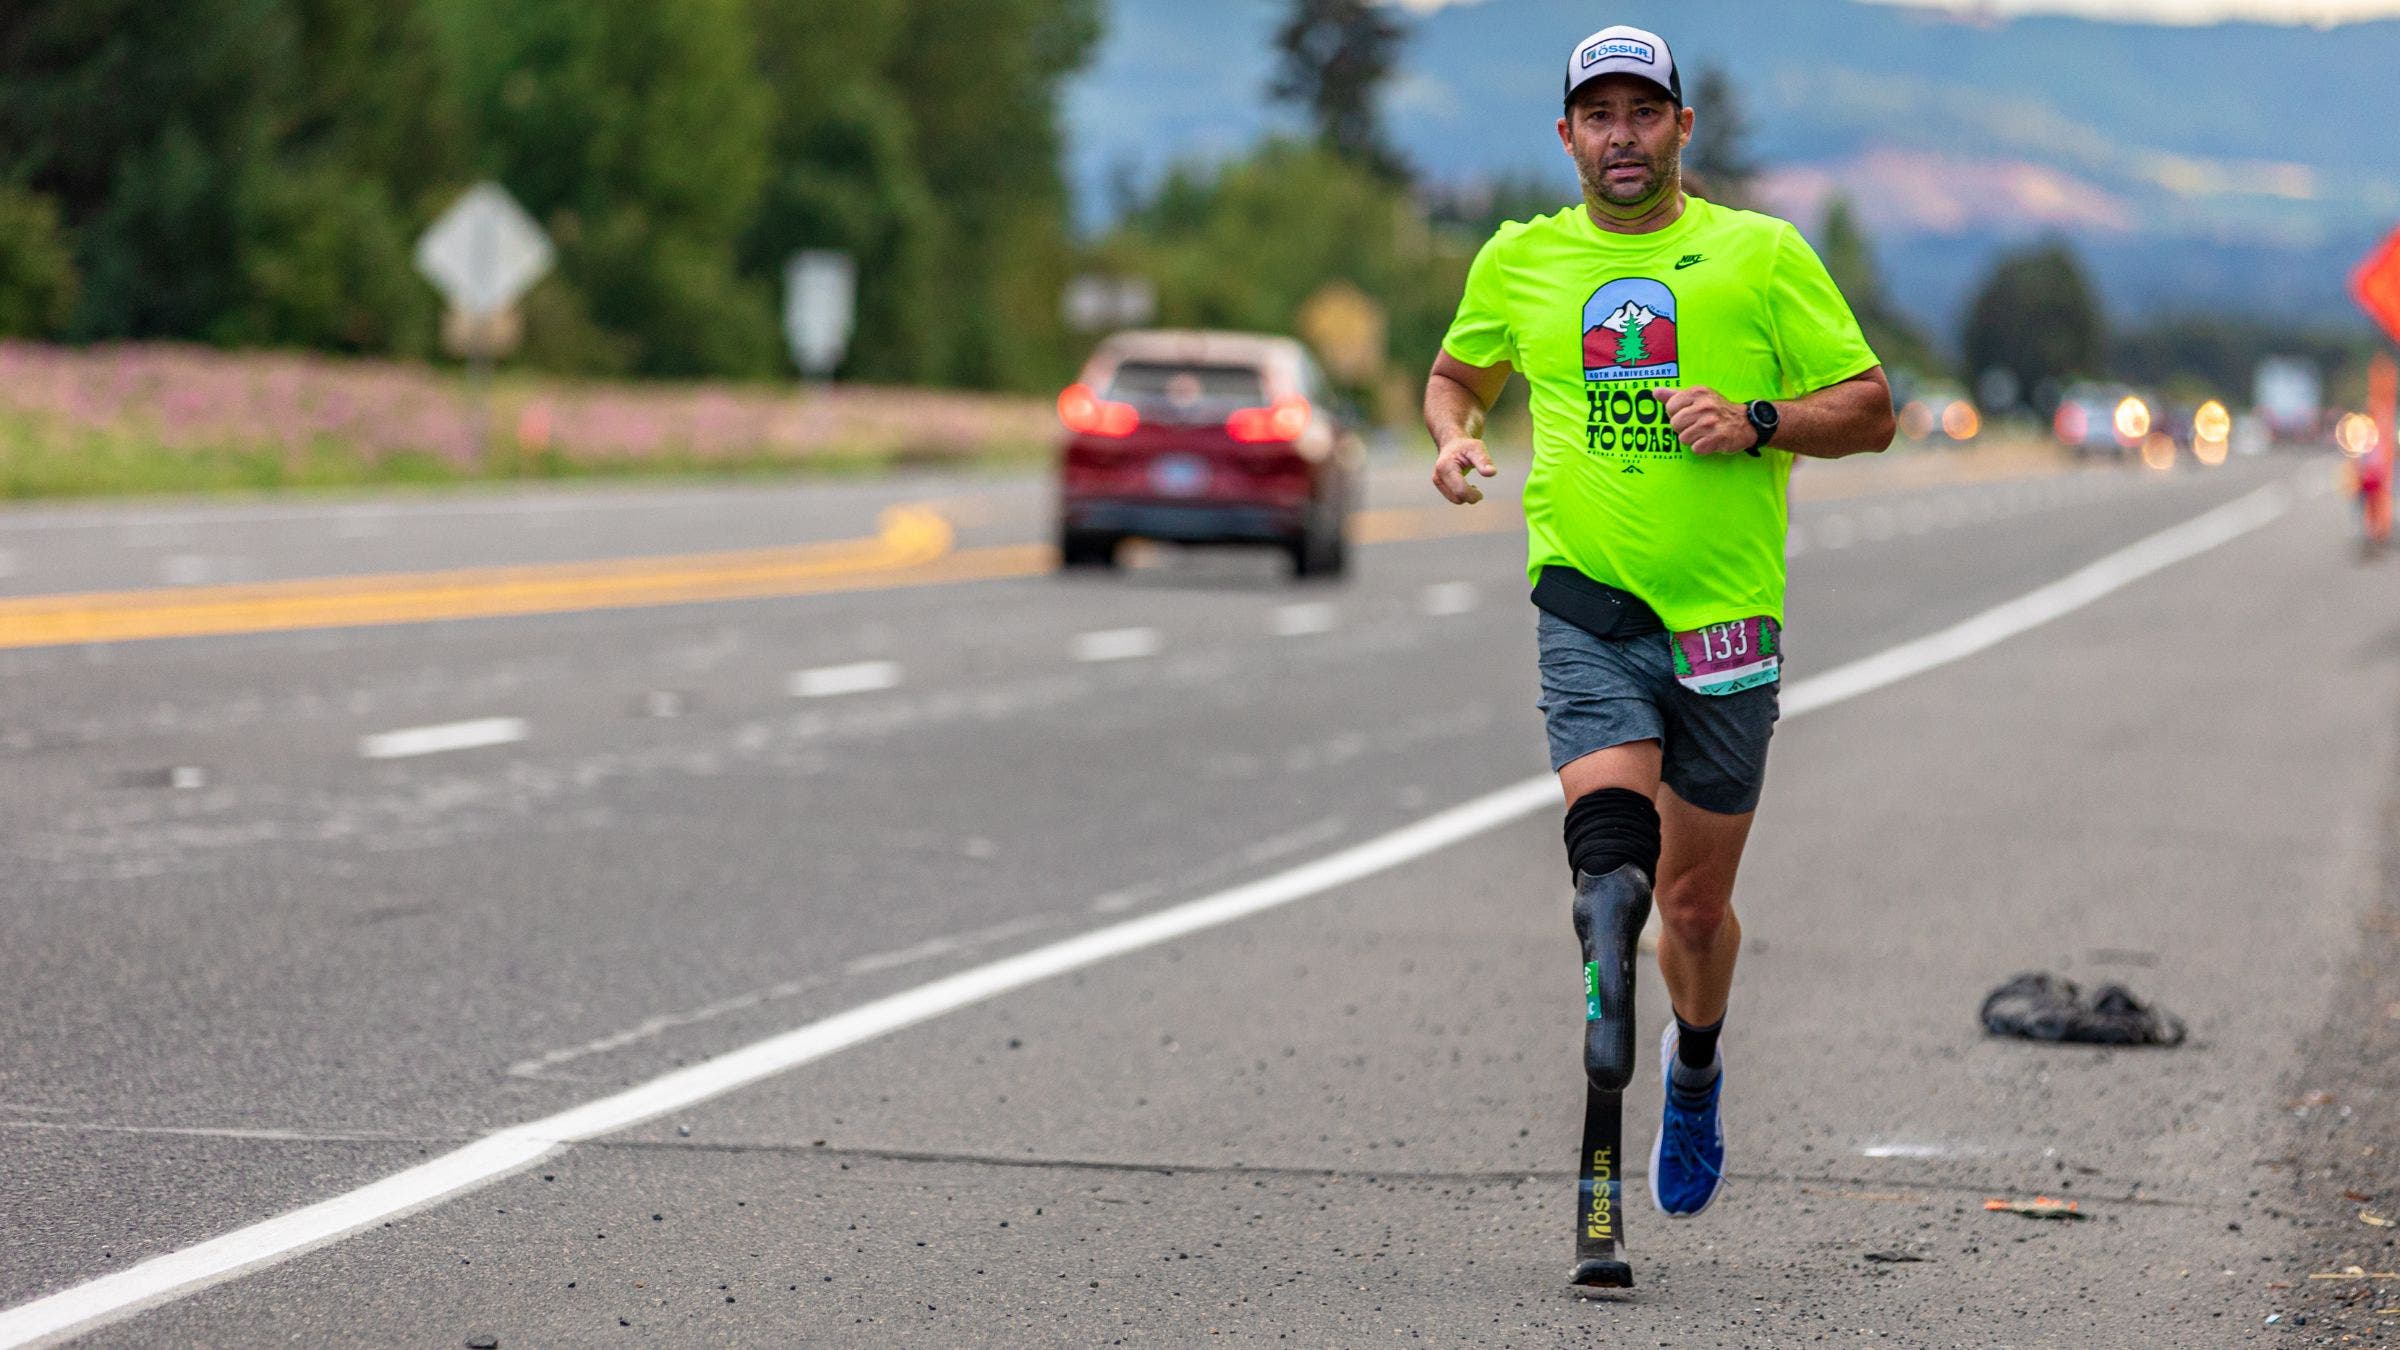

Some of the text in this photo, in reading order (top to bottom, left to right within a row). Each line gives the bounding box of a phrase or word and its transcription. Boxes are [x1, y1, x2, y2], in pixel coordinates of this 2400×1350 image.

[1613, 368, 1672, 377] ANNIVERSARY
[1584, 380, 1681, 389] PROVIDENCE
[1586, 425, 1616, 450] TO
[1698, 620, 1748, 662] 133
